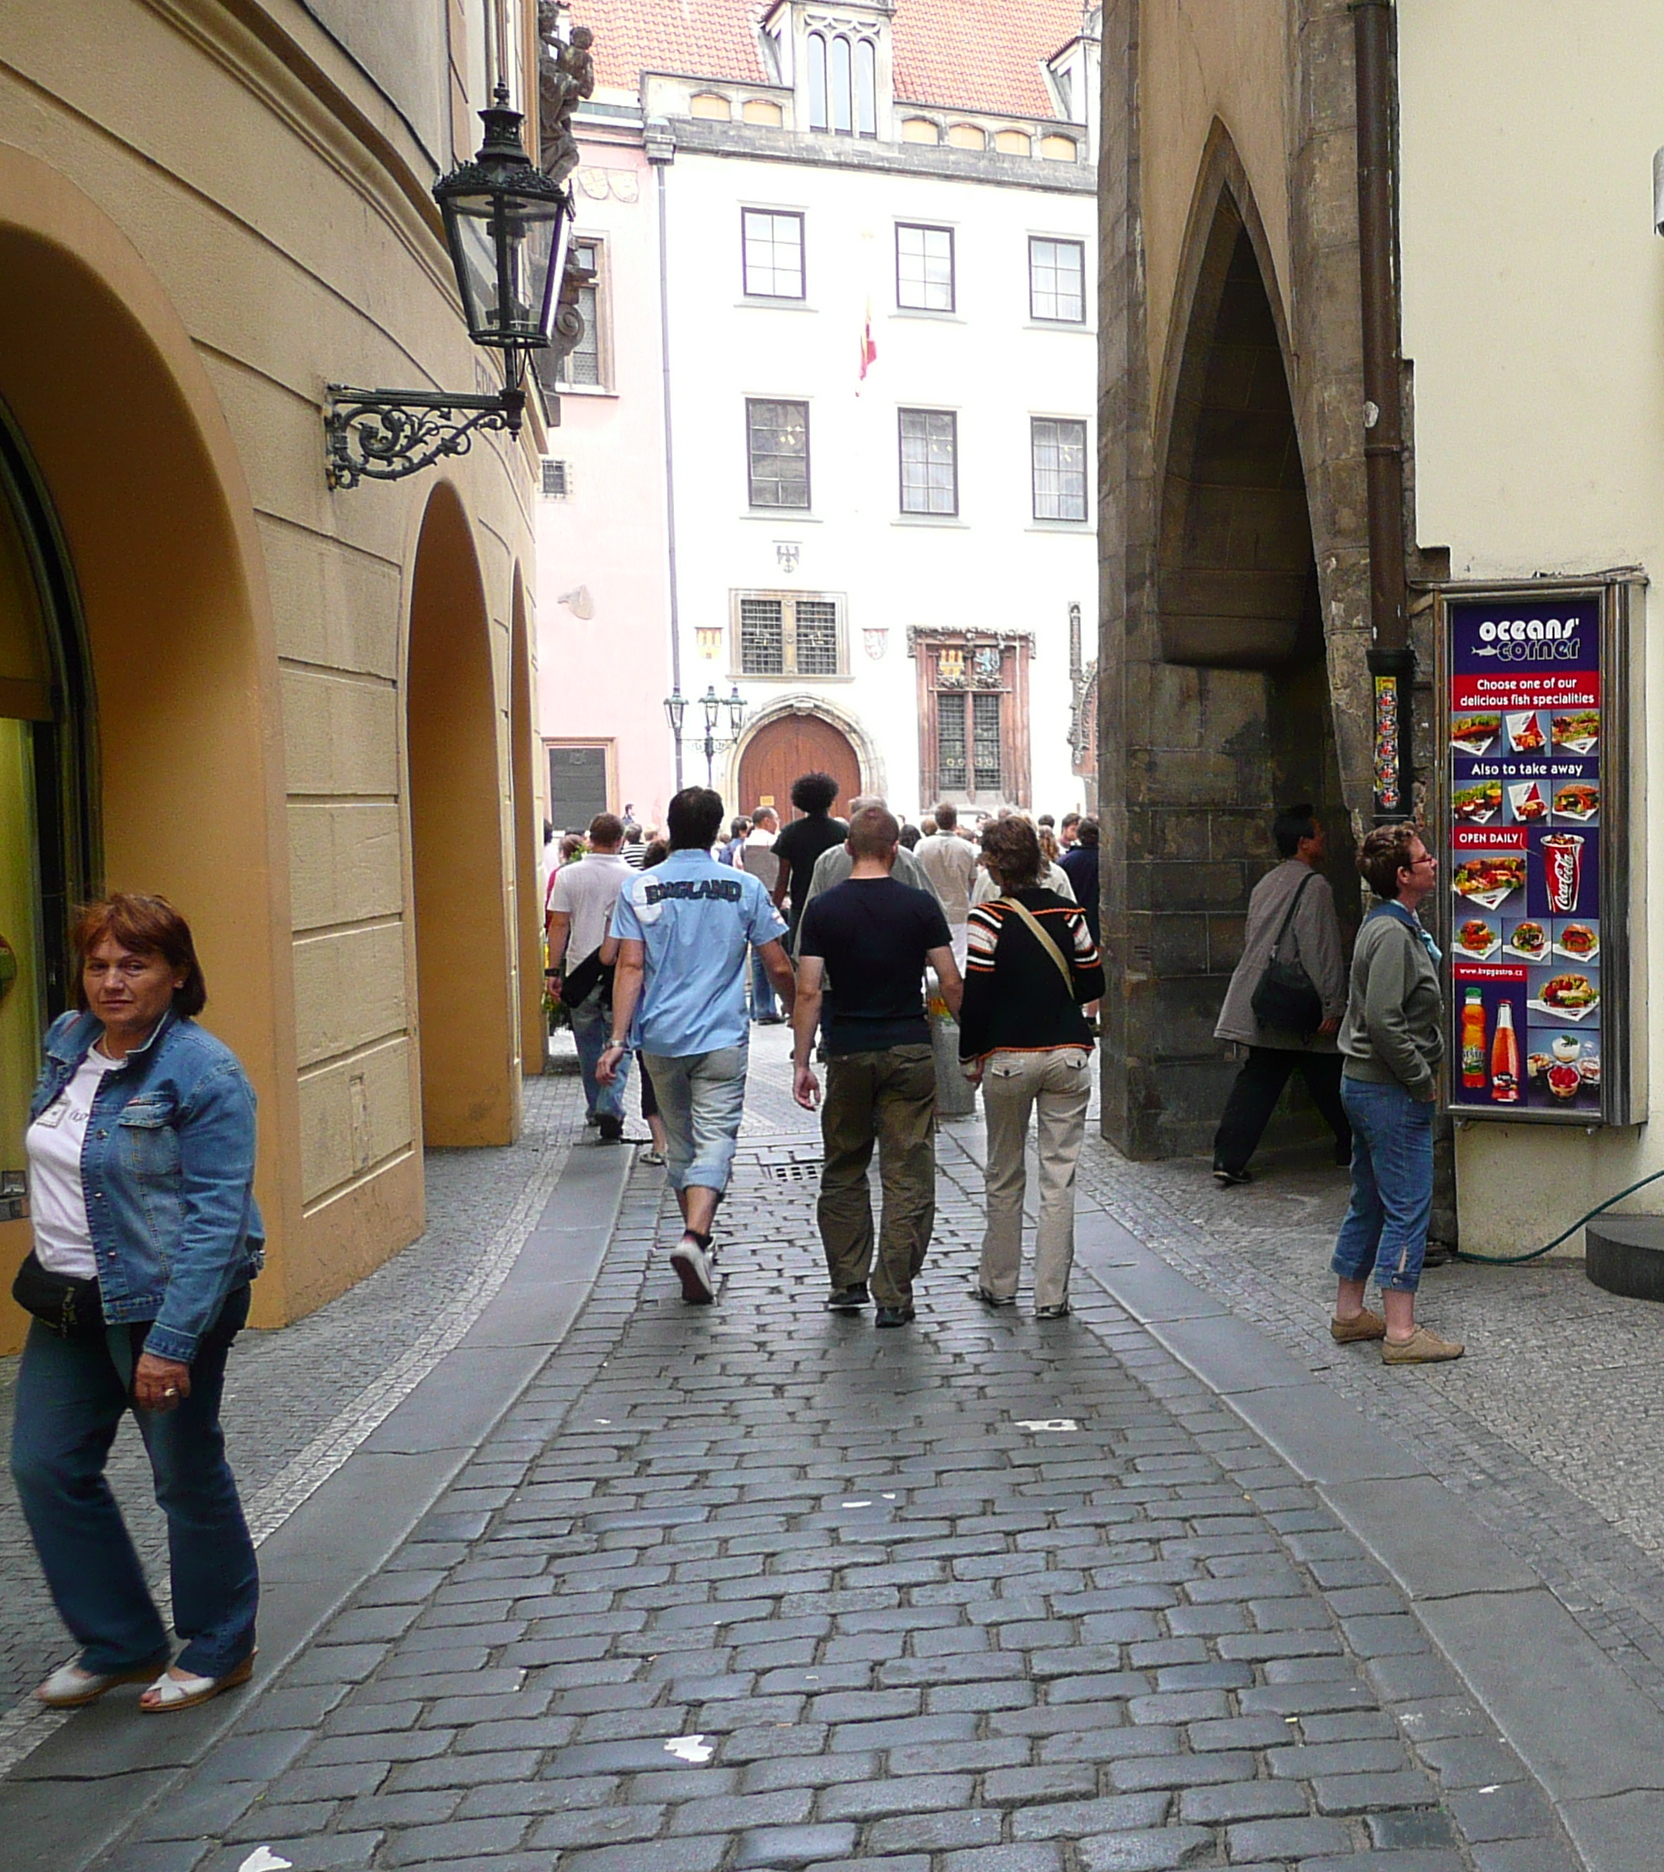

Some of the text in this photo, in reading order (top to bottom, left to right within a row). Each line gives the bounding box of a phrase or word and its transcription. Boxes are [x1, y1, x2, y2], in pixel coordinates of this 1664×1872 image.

[1497, 638, 1580, 662] corner
[1477, 678, 1577, 690] Choose one of our
[1460, 693, 1595, 707] delicious fish specialities
[1471, 763, 1583, 778] Also to take away
[1459, 833, 1518, 844] OPEN DAILY
[645, 879, 742, 905] ENGLAND
